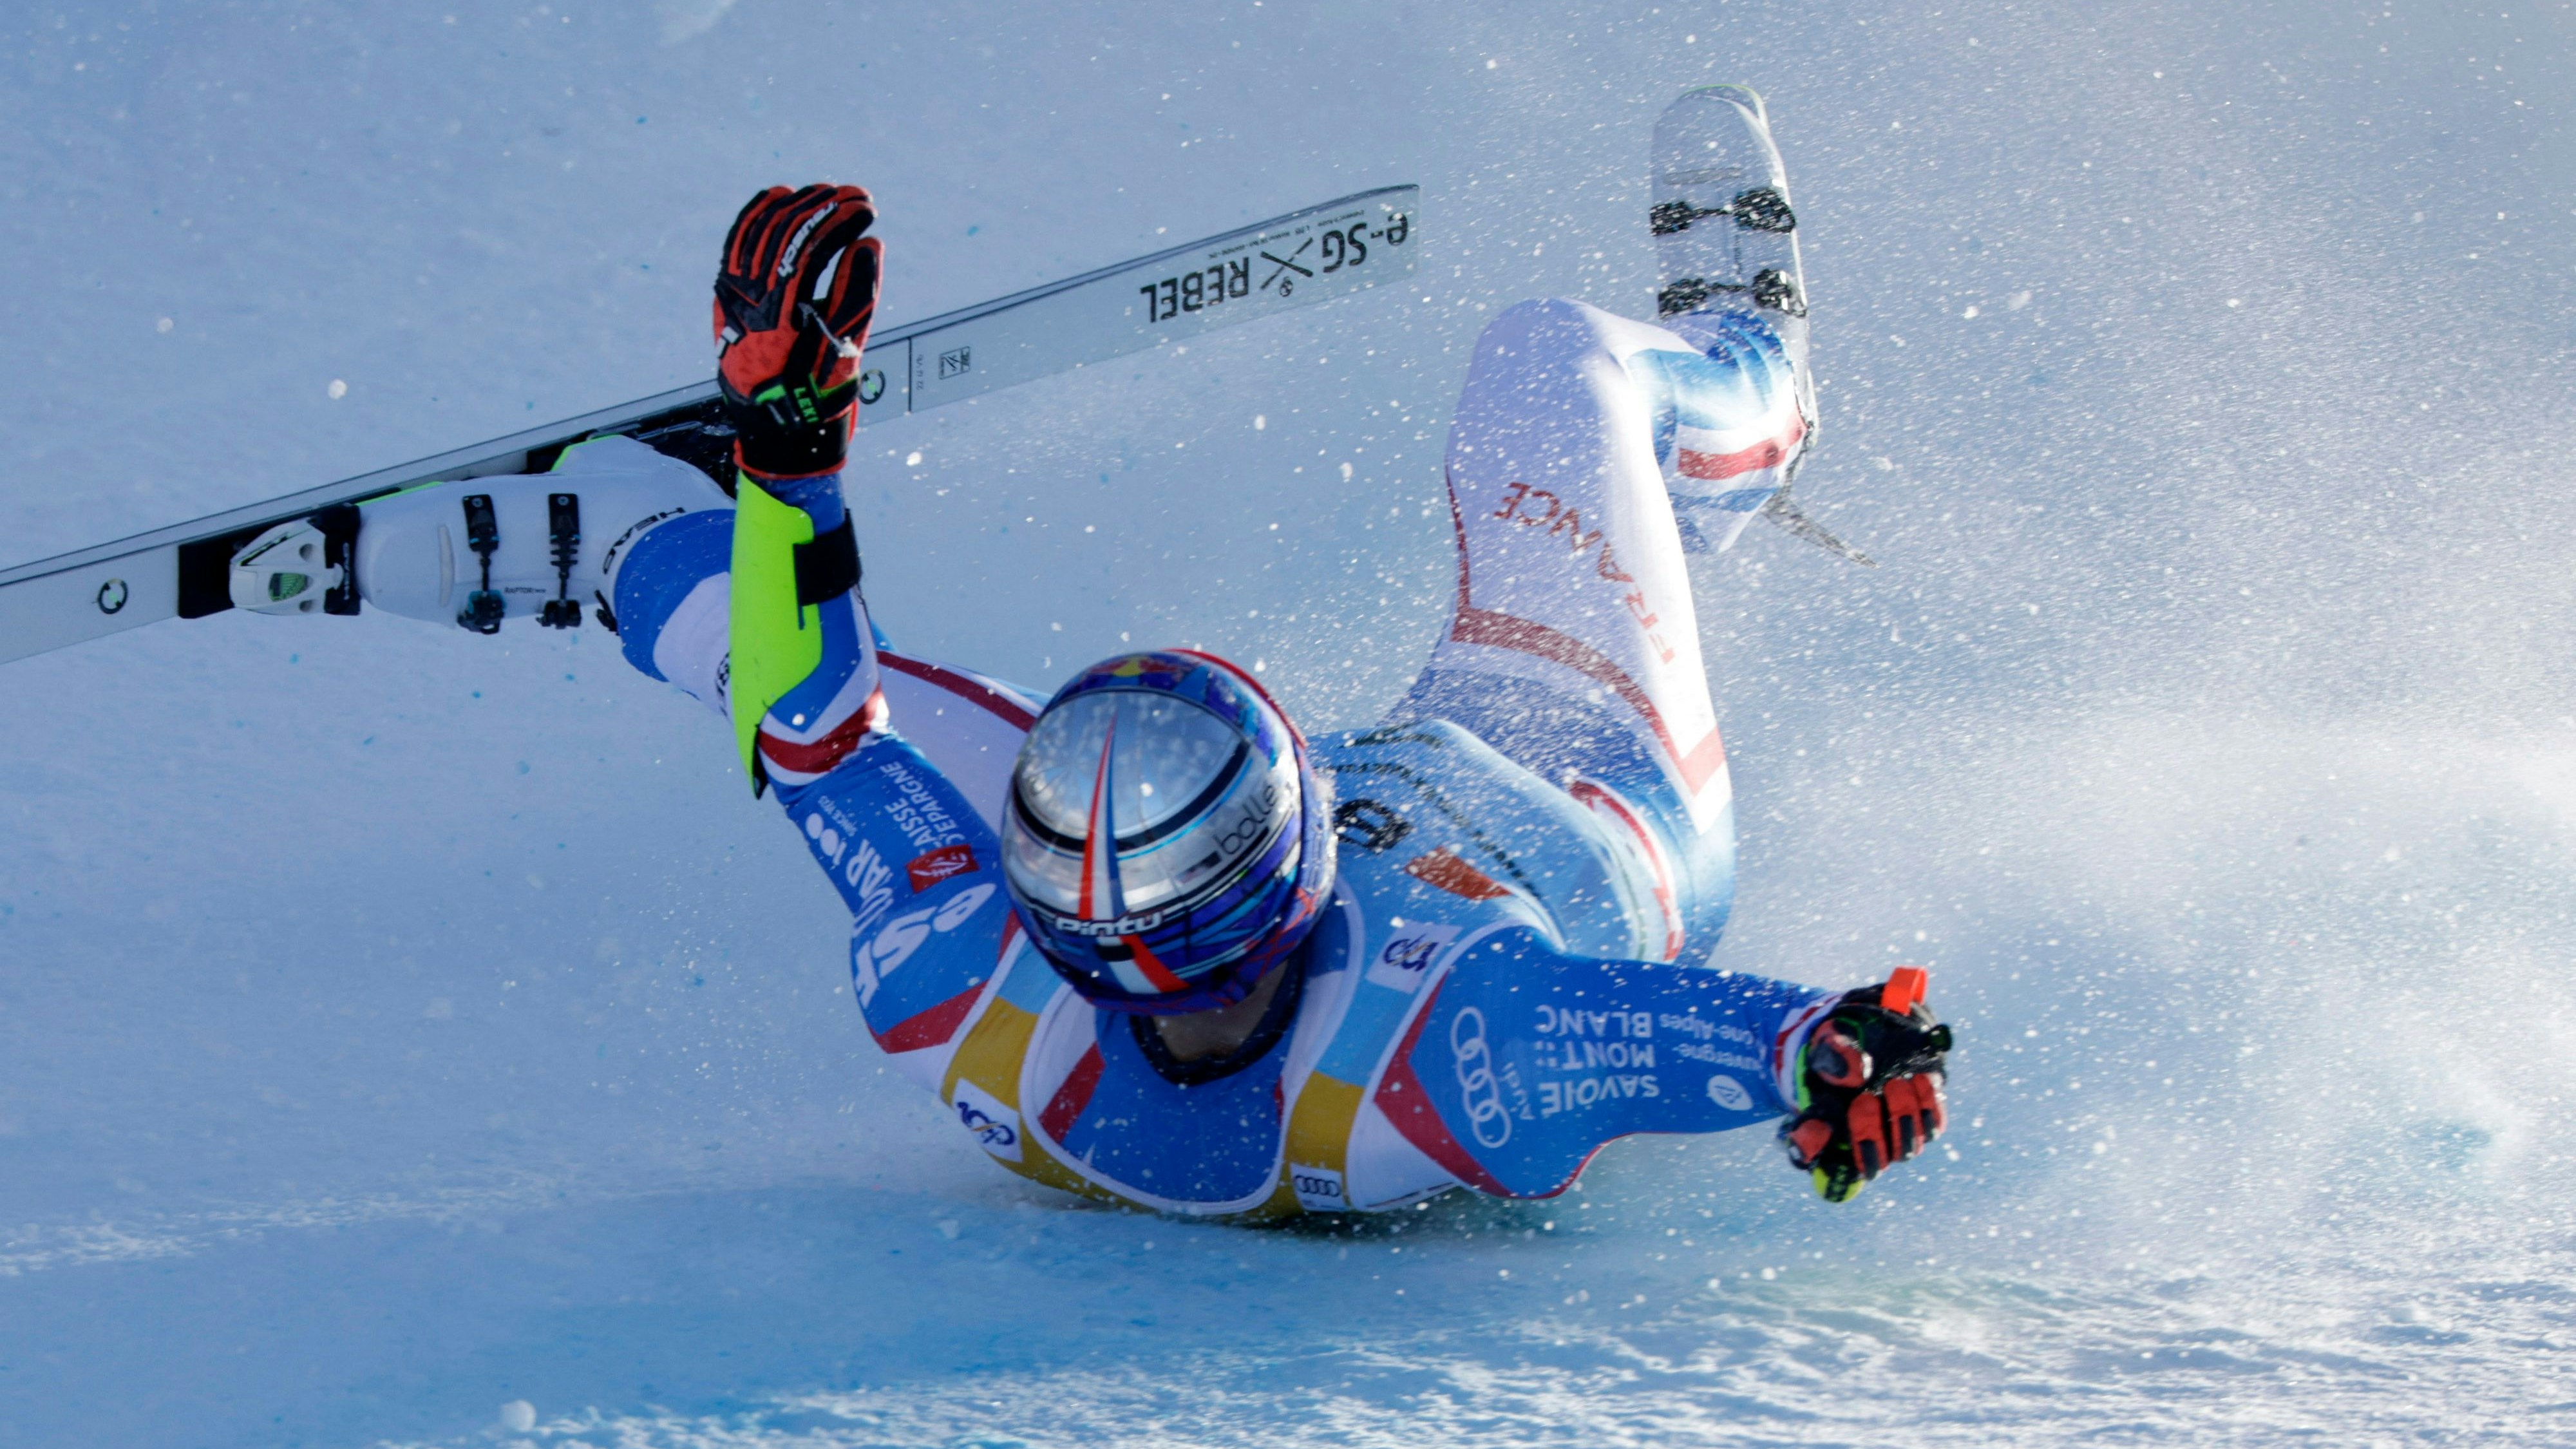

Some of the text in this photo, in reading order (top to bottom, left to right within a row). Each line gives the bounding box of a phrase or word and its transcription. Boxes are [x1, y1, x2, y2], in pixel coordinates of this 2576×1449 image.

[777, 201, 838, 277] reusch
[1140, 257, 1249, 323] REBEL
[793, 387, 820, 422] LEKI
[602, 507, 686, 574] HEAD
[1493, 481, 1676, 665] FRANCE
[1056, 910, 1165, 936] pintu
[1534, 1005, 1653, 1039] BLANC
[1561, 1039, 1657, 1071] MONT
[1539, 1075, 1660, 1118] SAVOIE
